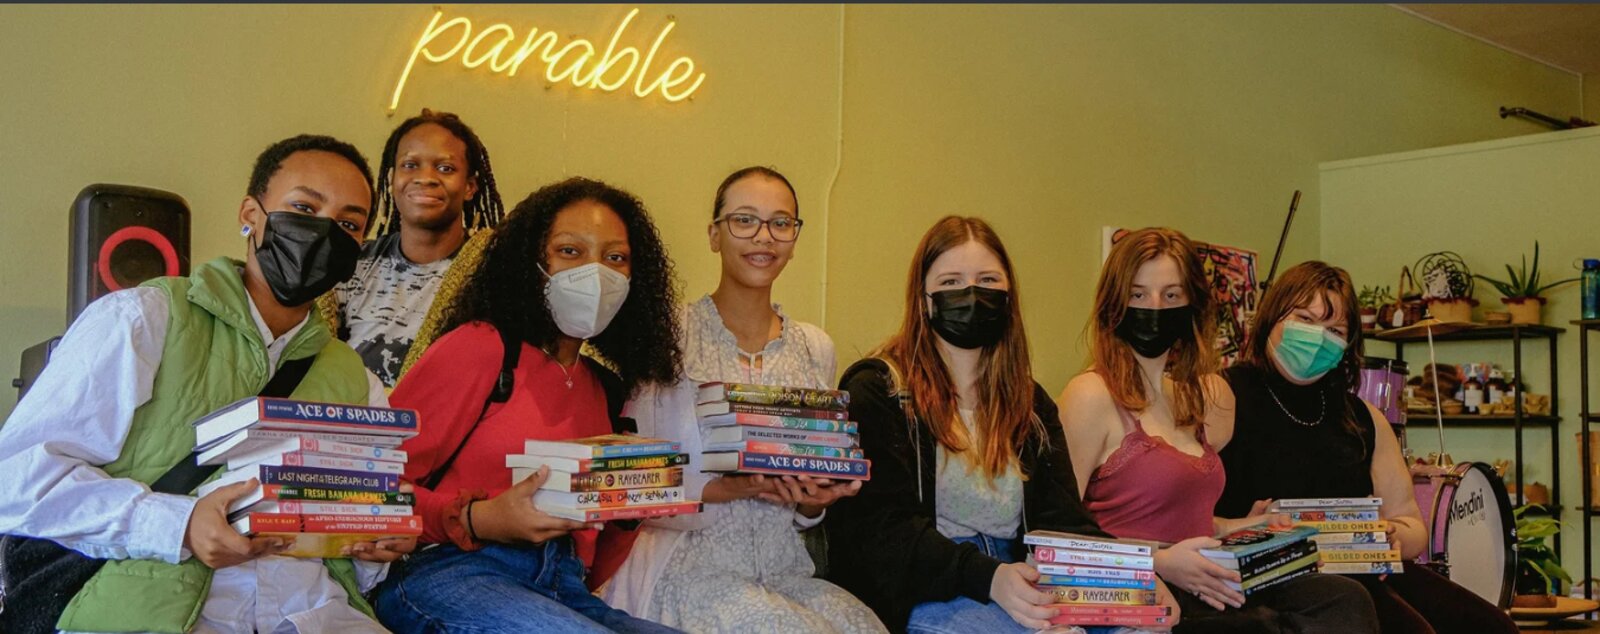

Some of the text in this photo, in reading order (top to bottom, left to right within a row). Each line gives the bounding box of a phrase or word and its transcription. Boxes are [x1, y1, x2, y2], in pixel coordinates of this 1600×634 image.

[389, 8, 706, 110] parable
[296, 404, 323, 419] ACE
[326, 406, 343, 420] OF
[346, 408, 396, 424] SPADES
[768, 456, 790, 468] ACE
[793, 459, 807, 468] OF
[809, 460, 850, 472] SPADES
[278, 472, 295, 481] LAST
[296, 474, 319, 483] NIGHT
[324, 475, 361, 486] TELEGRAPH
[362, 478, 379, 488] CLUB
[618, 472, 661, 485] RAYBEARER
[303, 488, 326, 499] FRESH
[1450, 488, 1485, 525] Mendini
[1070, 540, 1089, 548] Dear
[1328, 553, 1387, 561] GILDED ONES
[1082, 590, 1130, 602] RAYBEARER
